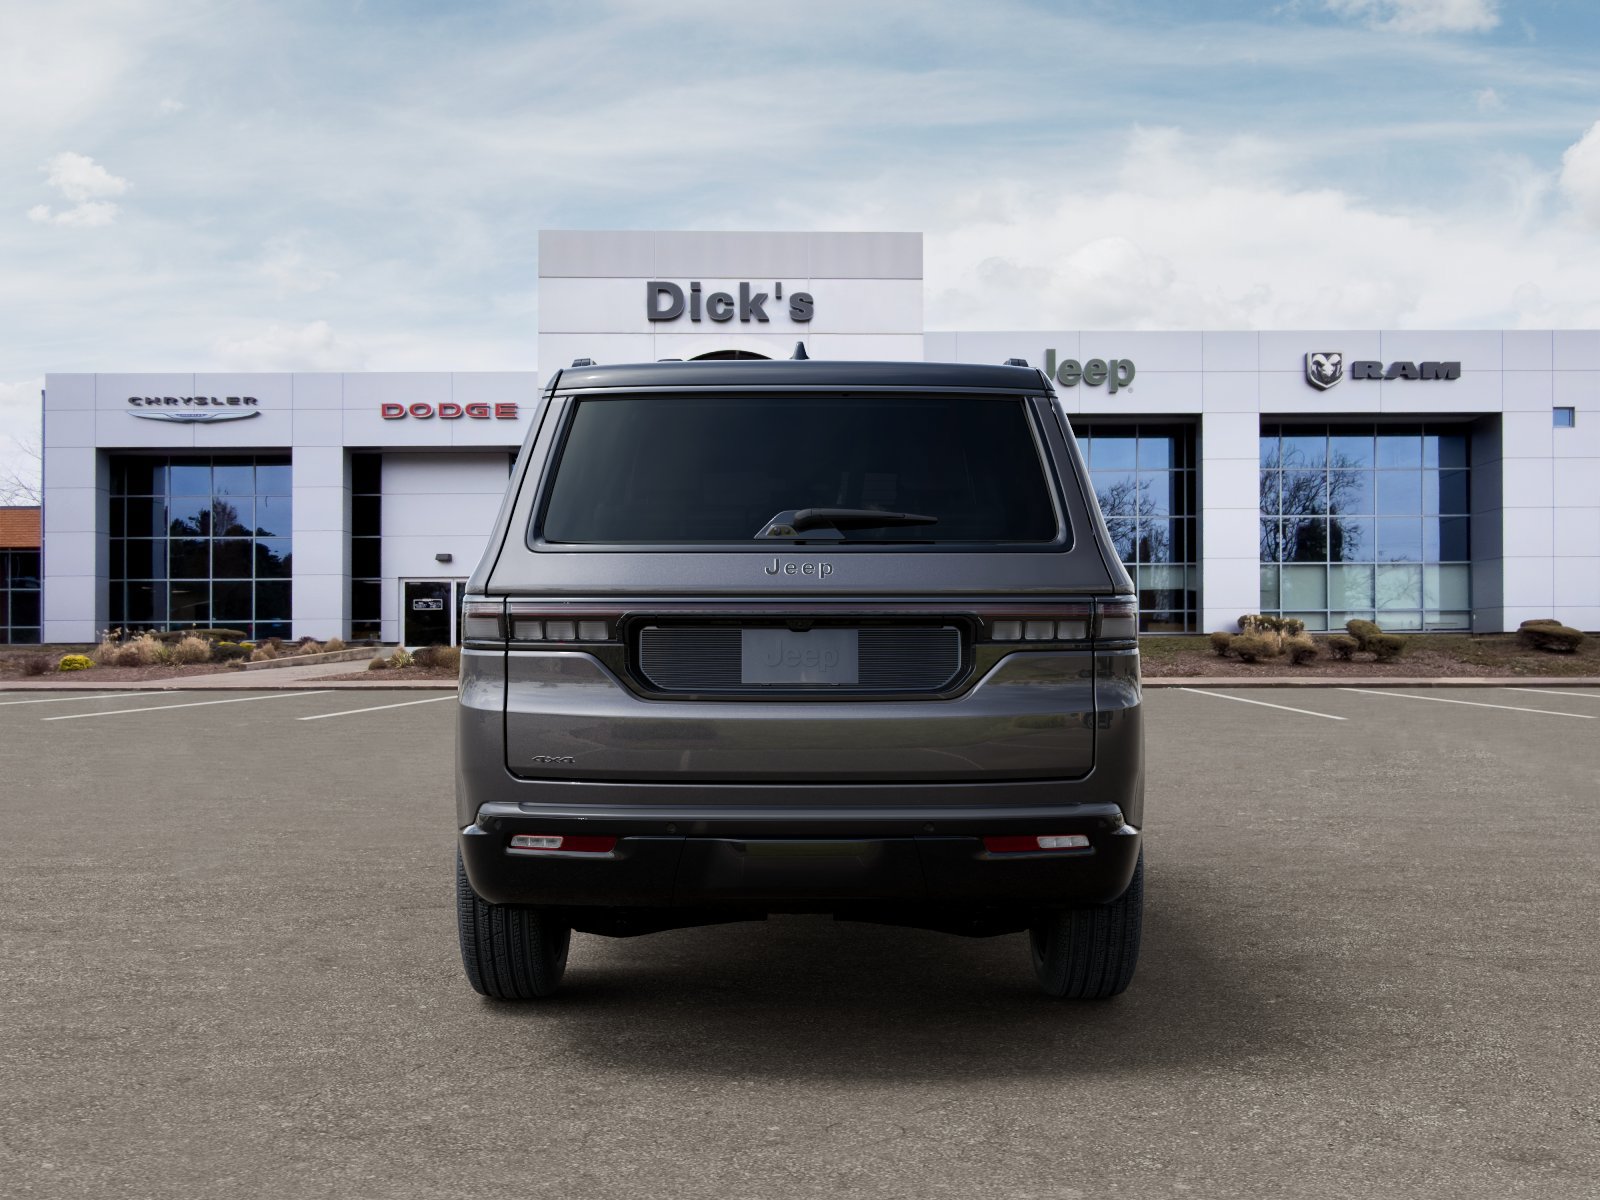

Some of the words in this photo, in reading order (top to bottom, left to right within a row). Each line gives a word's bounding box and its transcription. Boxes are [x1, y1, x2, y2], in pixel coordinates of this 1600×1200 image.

[647, 281, 814, 322] Dick's
[1045, 348, 1136, 394] Jeep
[1352, 361, 1461, 380] RAM
[128, 396, 258, 406] CHRYSLER
[381, 402, 519, 420] DODGE
[764, 558, 834, 579] Jeep
[764, 639, 840, 672] Jeep
